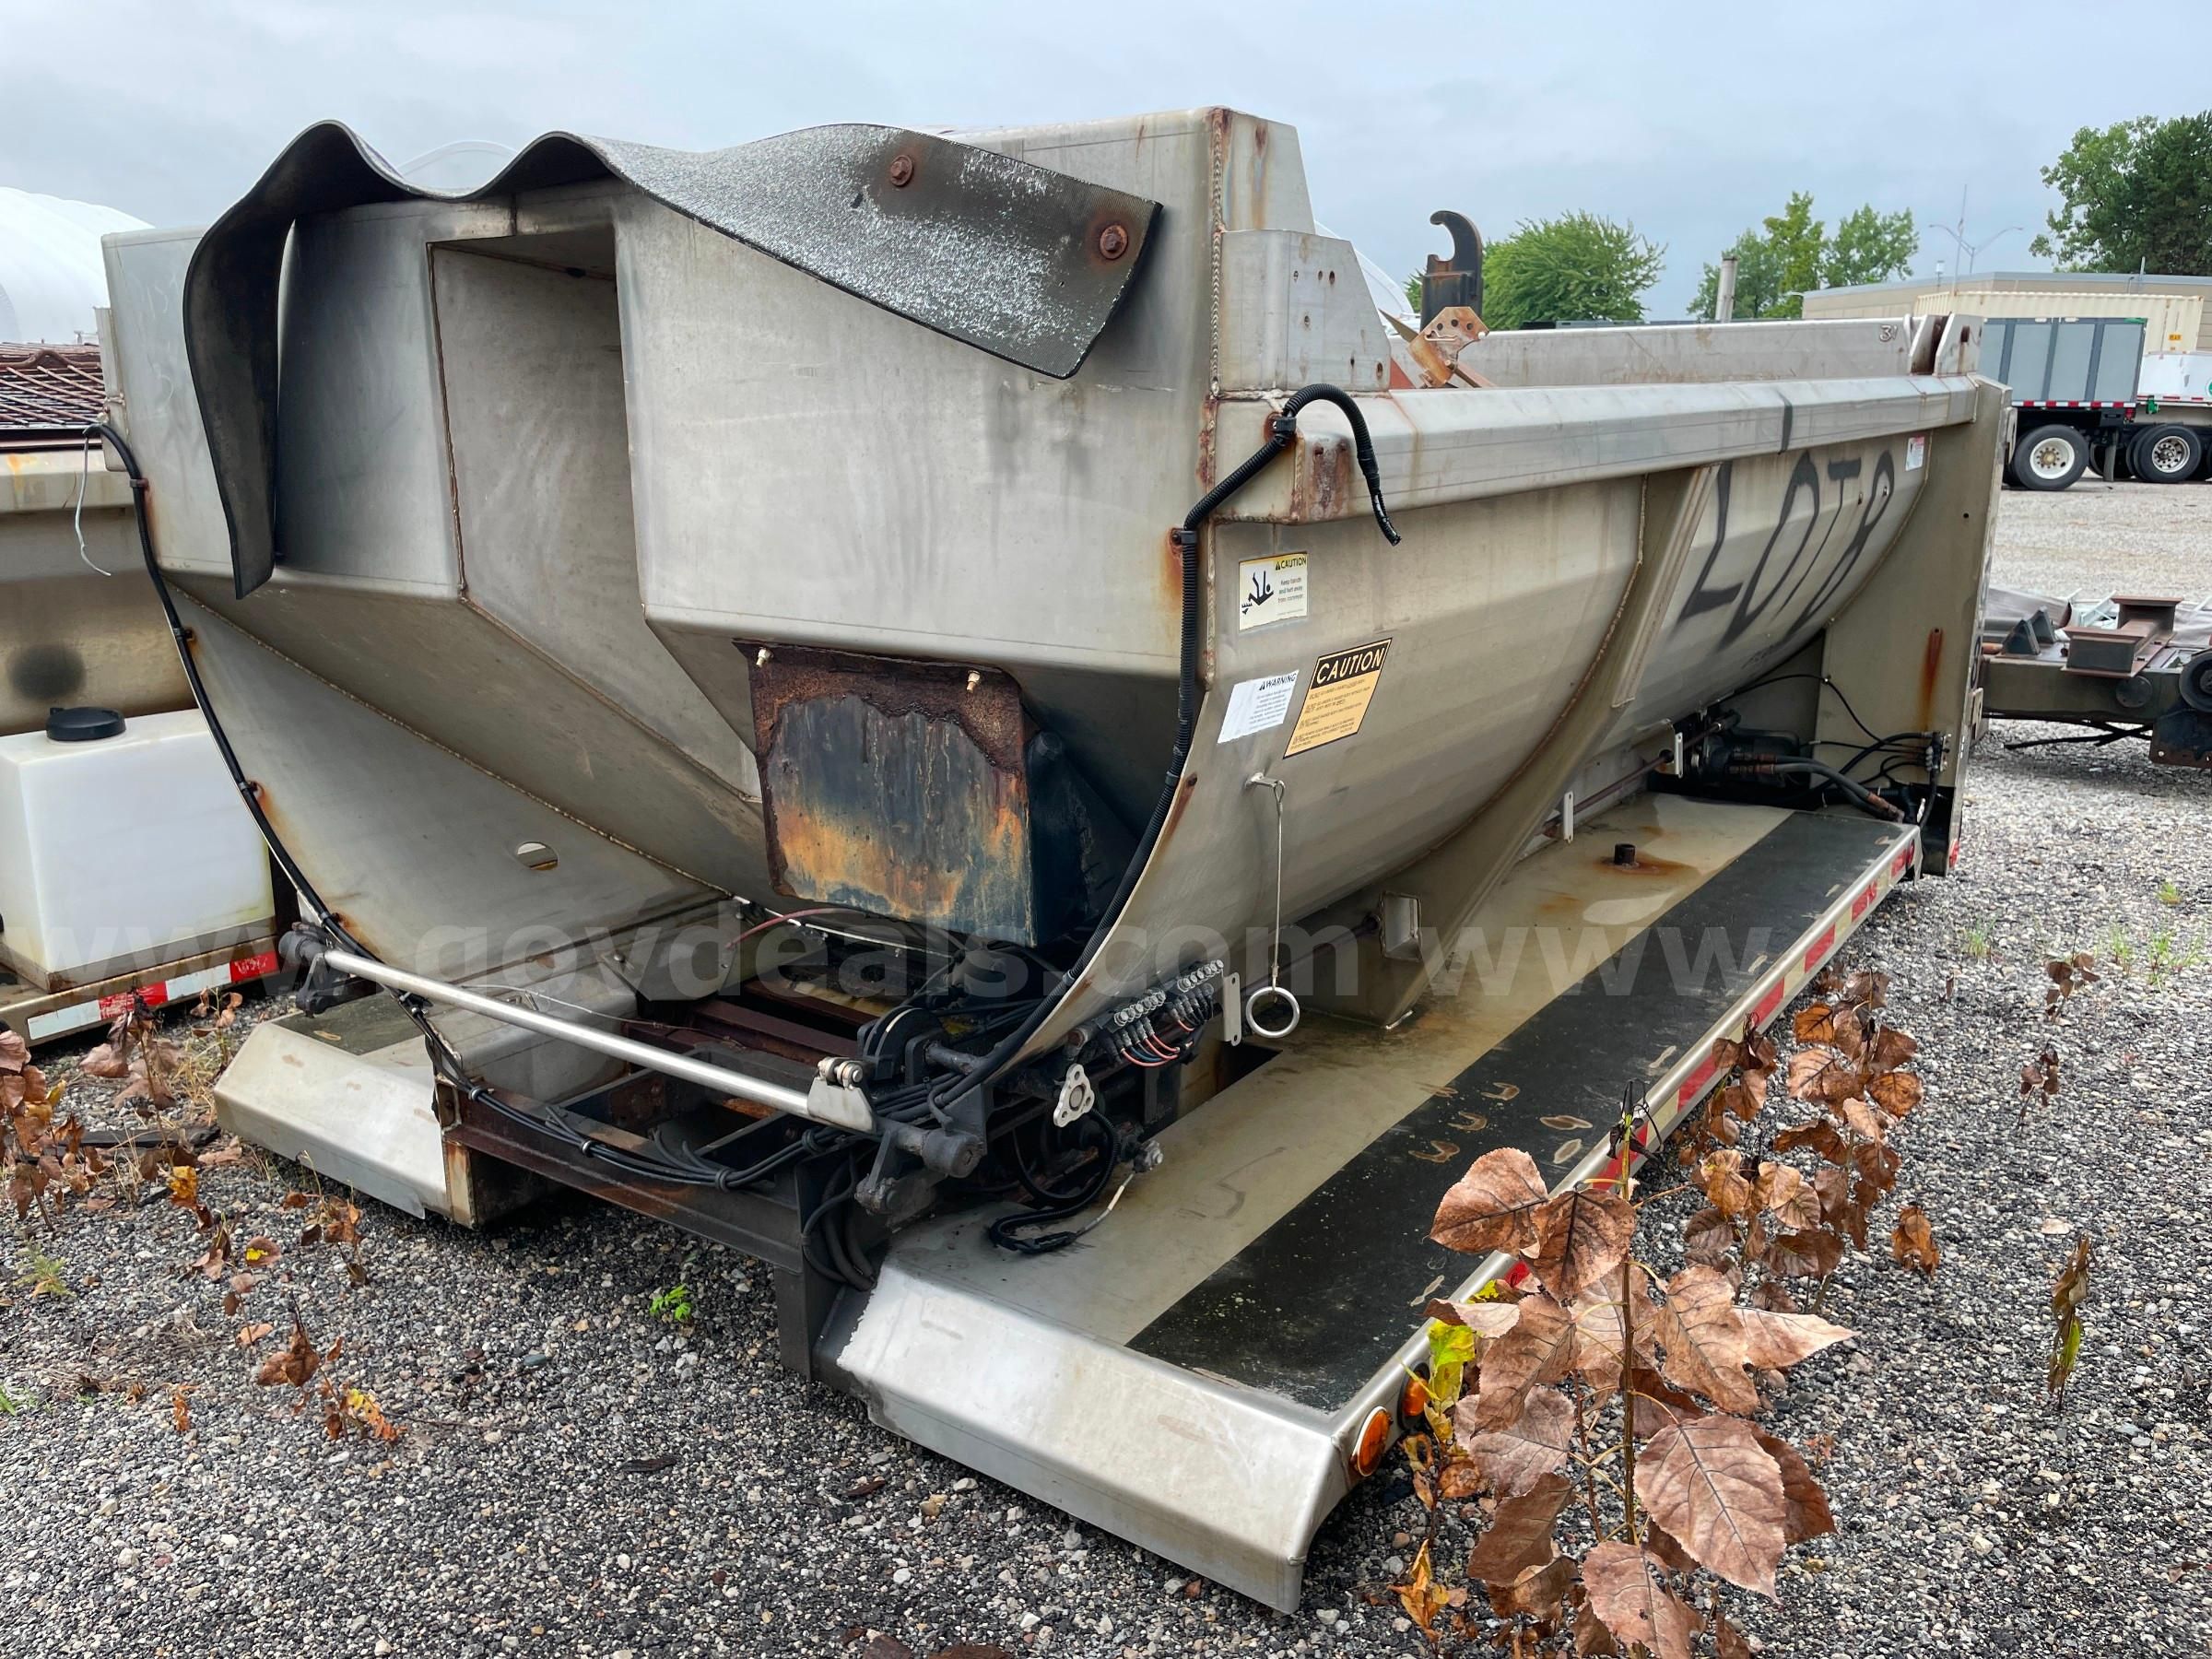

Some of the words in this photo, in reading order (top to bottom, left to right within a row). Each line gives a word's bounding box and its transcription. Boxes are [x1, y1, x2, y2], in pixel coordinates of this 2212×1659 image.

[1280, 557, 1307, 569] CAUTION
[1316, 647, 1385, 684] CAUTION
[1265, 673, 1297, 688] WARNING
